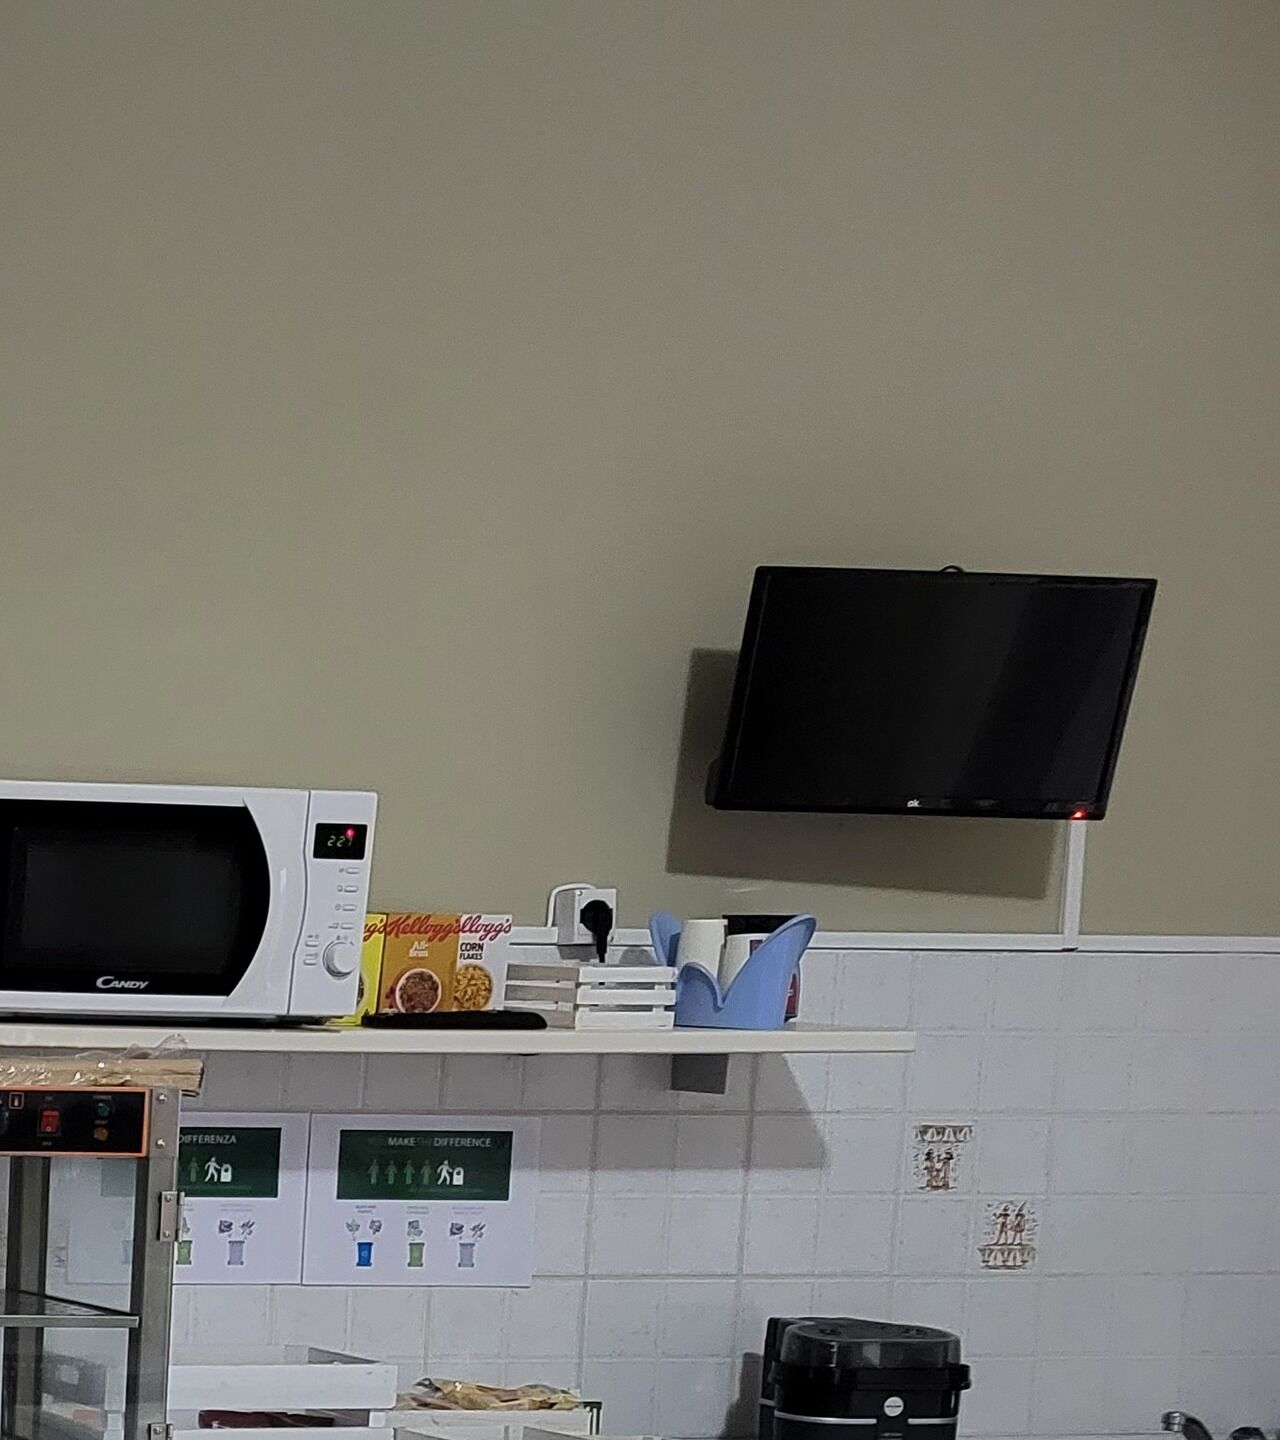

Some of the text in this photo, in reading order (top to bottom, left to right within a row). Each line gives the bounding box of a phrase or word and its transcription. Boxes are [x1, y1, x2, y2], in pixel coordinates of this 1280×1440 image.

[387, 915, 460, 942] Kellogg's
[460, 915, 512, 941] llogg's
[460, 942, 484, 952] CORN
[459, 952, 483, 960] FLAKES
[95, 975, 150, 990] CANDY
[179, 1134, 237, 1144] DIFFERENZA
[388, 1136, 491, 1148] MAKE DIFFERENCE
